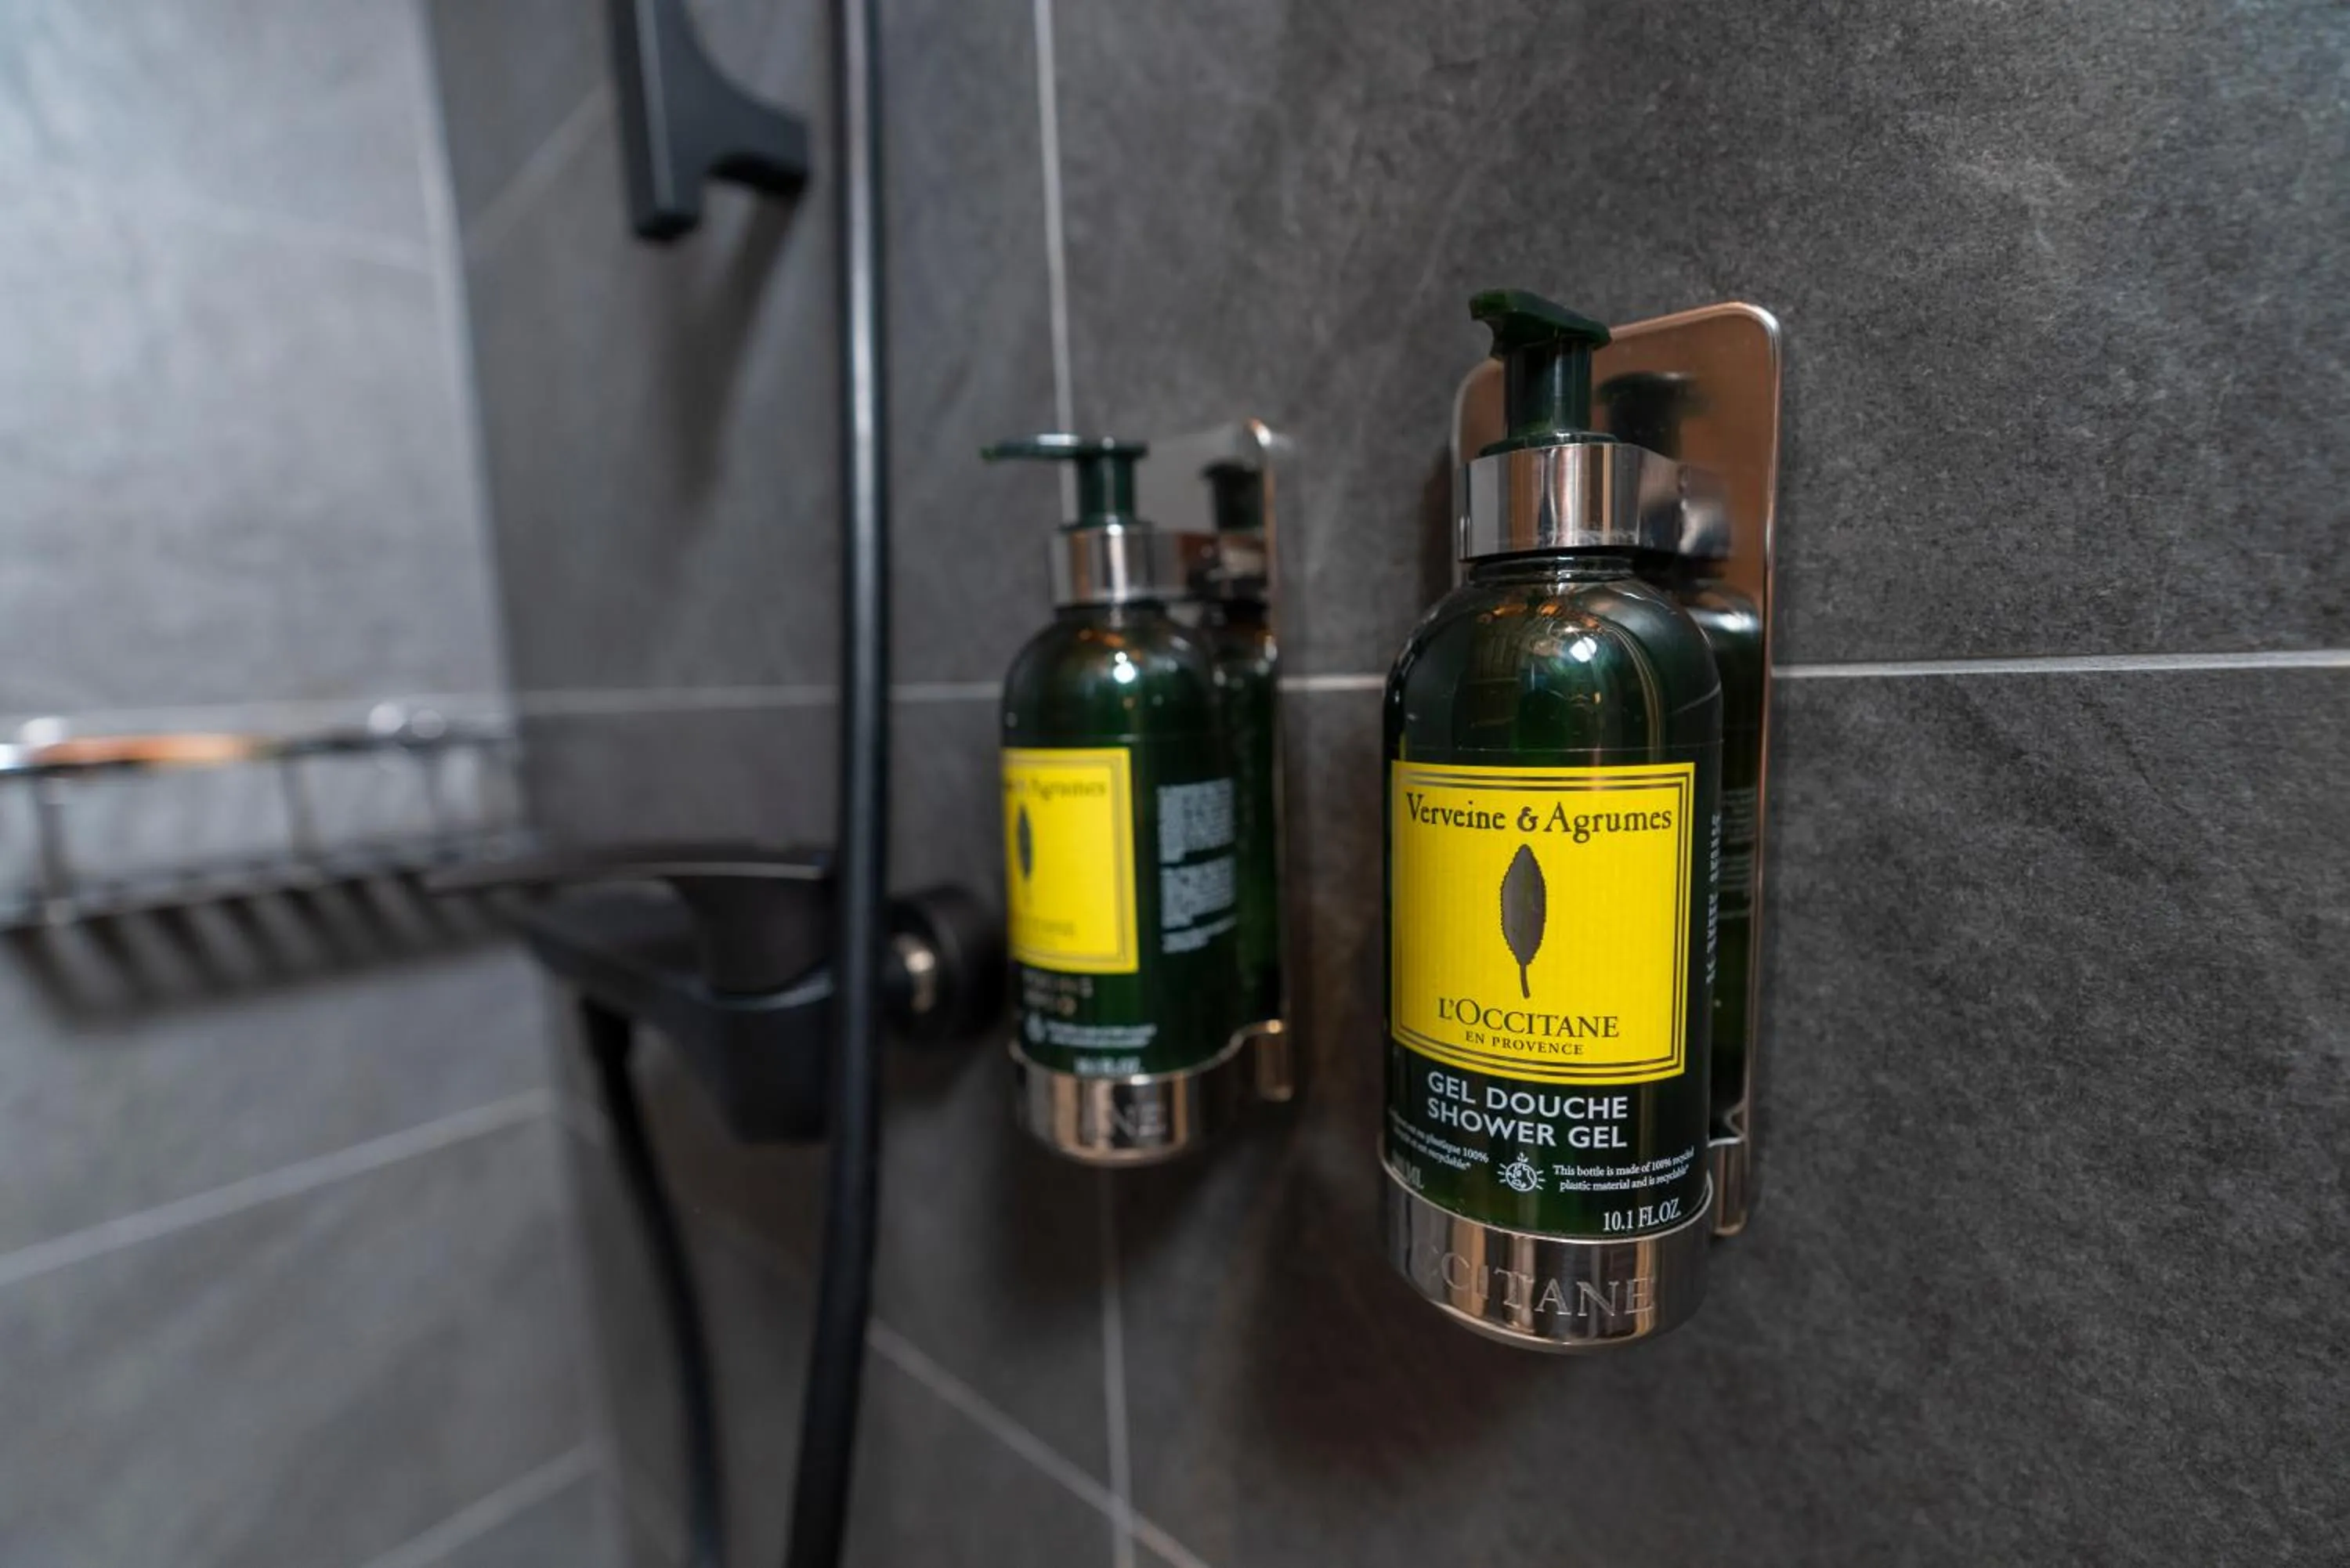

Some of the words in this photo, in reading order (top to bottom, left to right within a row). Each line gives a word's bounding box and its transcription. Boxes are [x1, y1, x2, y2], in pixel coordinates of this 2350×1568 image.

[1406, 792, 1506, 830] Verveine
[1517, 806, 1538, 832] &
[1543, 801, 1673, 844] Agrumes
[1466, 1031, 1485, 1044] EN
[1492, 1037, 1585, 1055] PROVENCE
[1427, 1071, 1477, 1104] GEL
[1486, 1086, 1629, 1120] DOUCHE
[1427, 1097, 1557, 1147] SHOWER
[1567, 1125, 1629, 1149] GEL
[1462, 1147, 1489, 1164] 100%
[1553, 1164, 1575, 1176] This
[1577, 1165, 1605, 1176] bottle
[1607, 1165, 1614, 1176] is
[1616, 1162, 1640, 1176] made
[1641, 1161, 1651, 1172] of
[1652, 1158, 1672, 1172] 100%
[1560, 1179, 1592, 1193] plastic
[1593, 1178, 1630, 1190] material
[1632, 1176, 1647, 1189] and
[1649, 1175, 1655, 1186] is
[1603, 1209, 1634, 1232] 10.1
